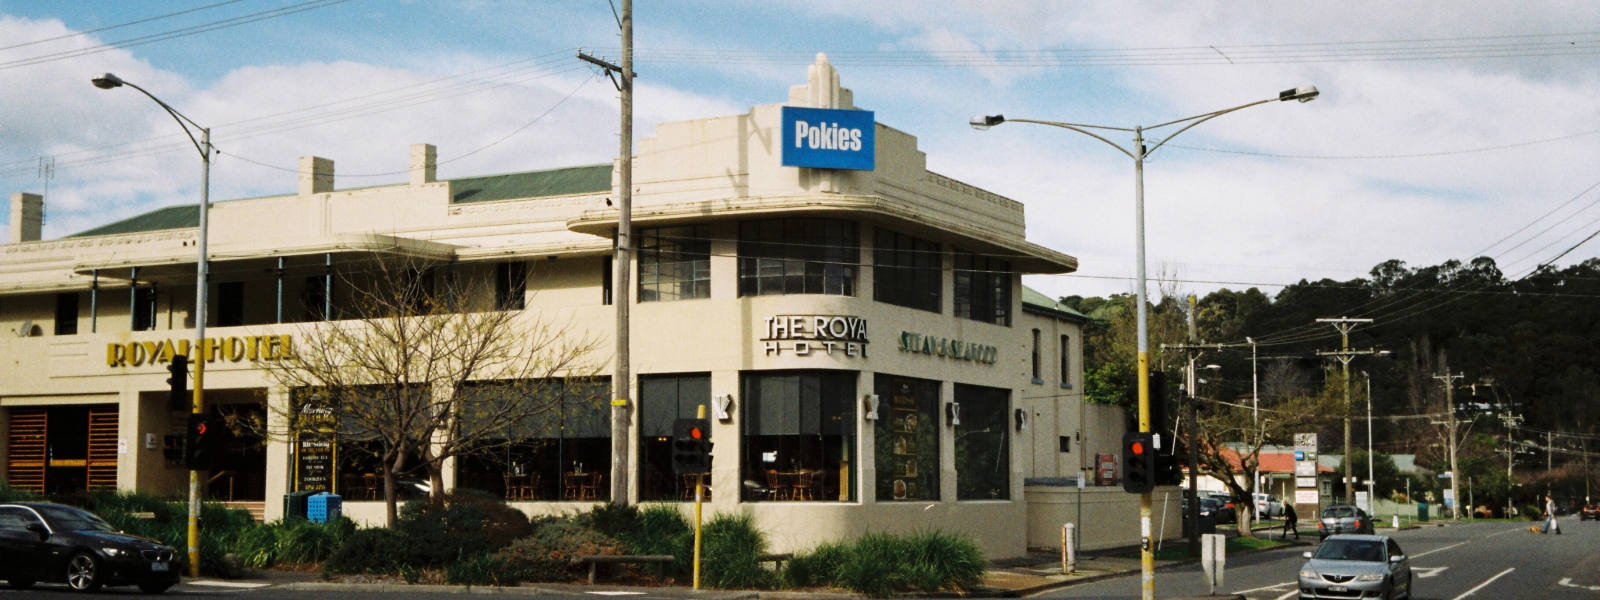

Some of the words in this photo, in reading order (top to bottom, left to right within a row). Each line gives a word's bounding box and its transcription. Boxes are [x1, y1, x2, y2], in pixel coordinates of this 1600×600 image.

[795, 120, 862, 152] Pokies
[764, 316, 804, 338] THE
[107, 337, 196, 367] ROYAL
[203, 334, 297, 363] HOTEL
[949, 339, 998, 365] SEAFOOD
